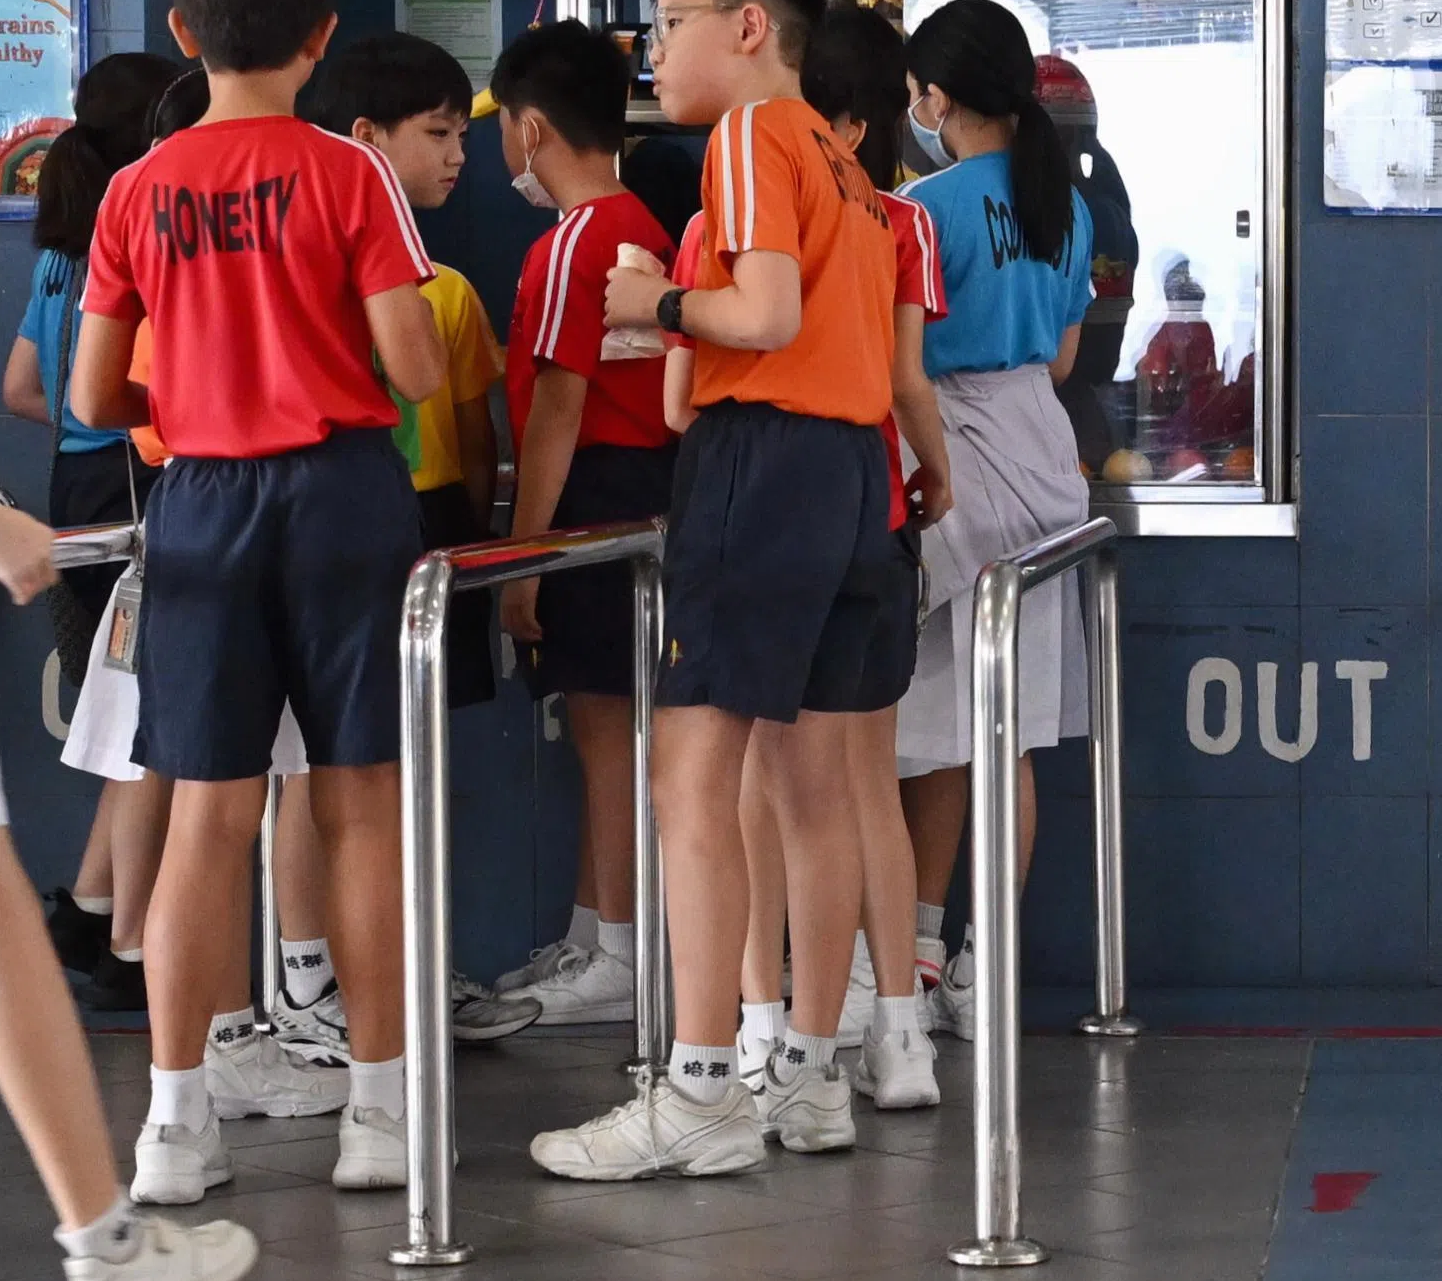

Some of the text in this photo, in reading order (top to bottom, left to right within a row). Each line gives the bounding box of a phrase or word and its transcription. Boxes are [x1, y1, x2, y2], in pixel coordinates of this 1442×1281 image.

[152, 171, 299, 267] HONESTY
[1186, 657, 1389, 763] OUT
[682, 1060, 732, 1080] 培群
